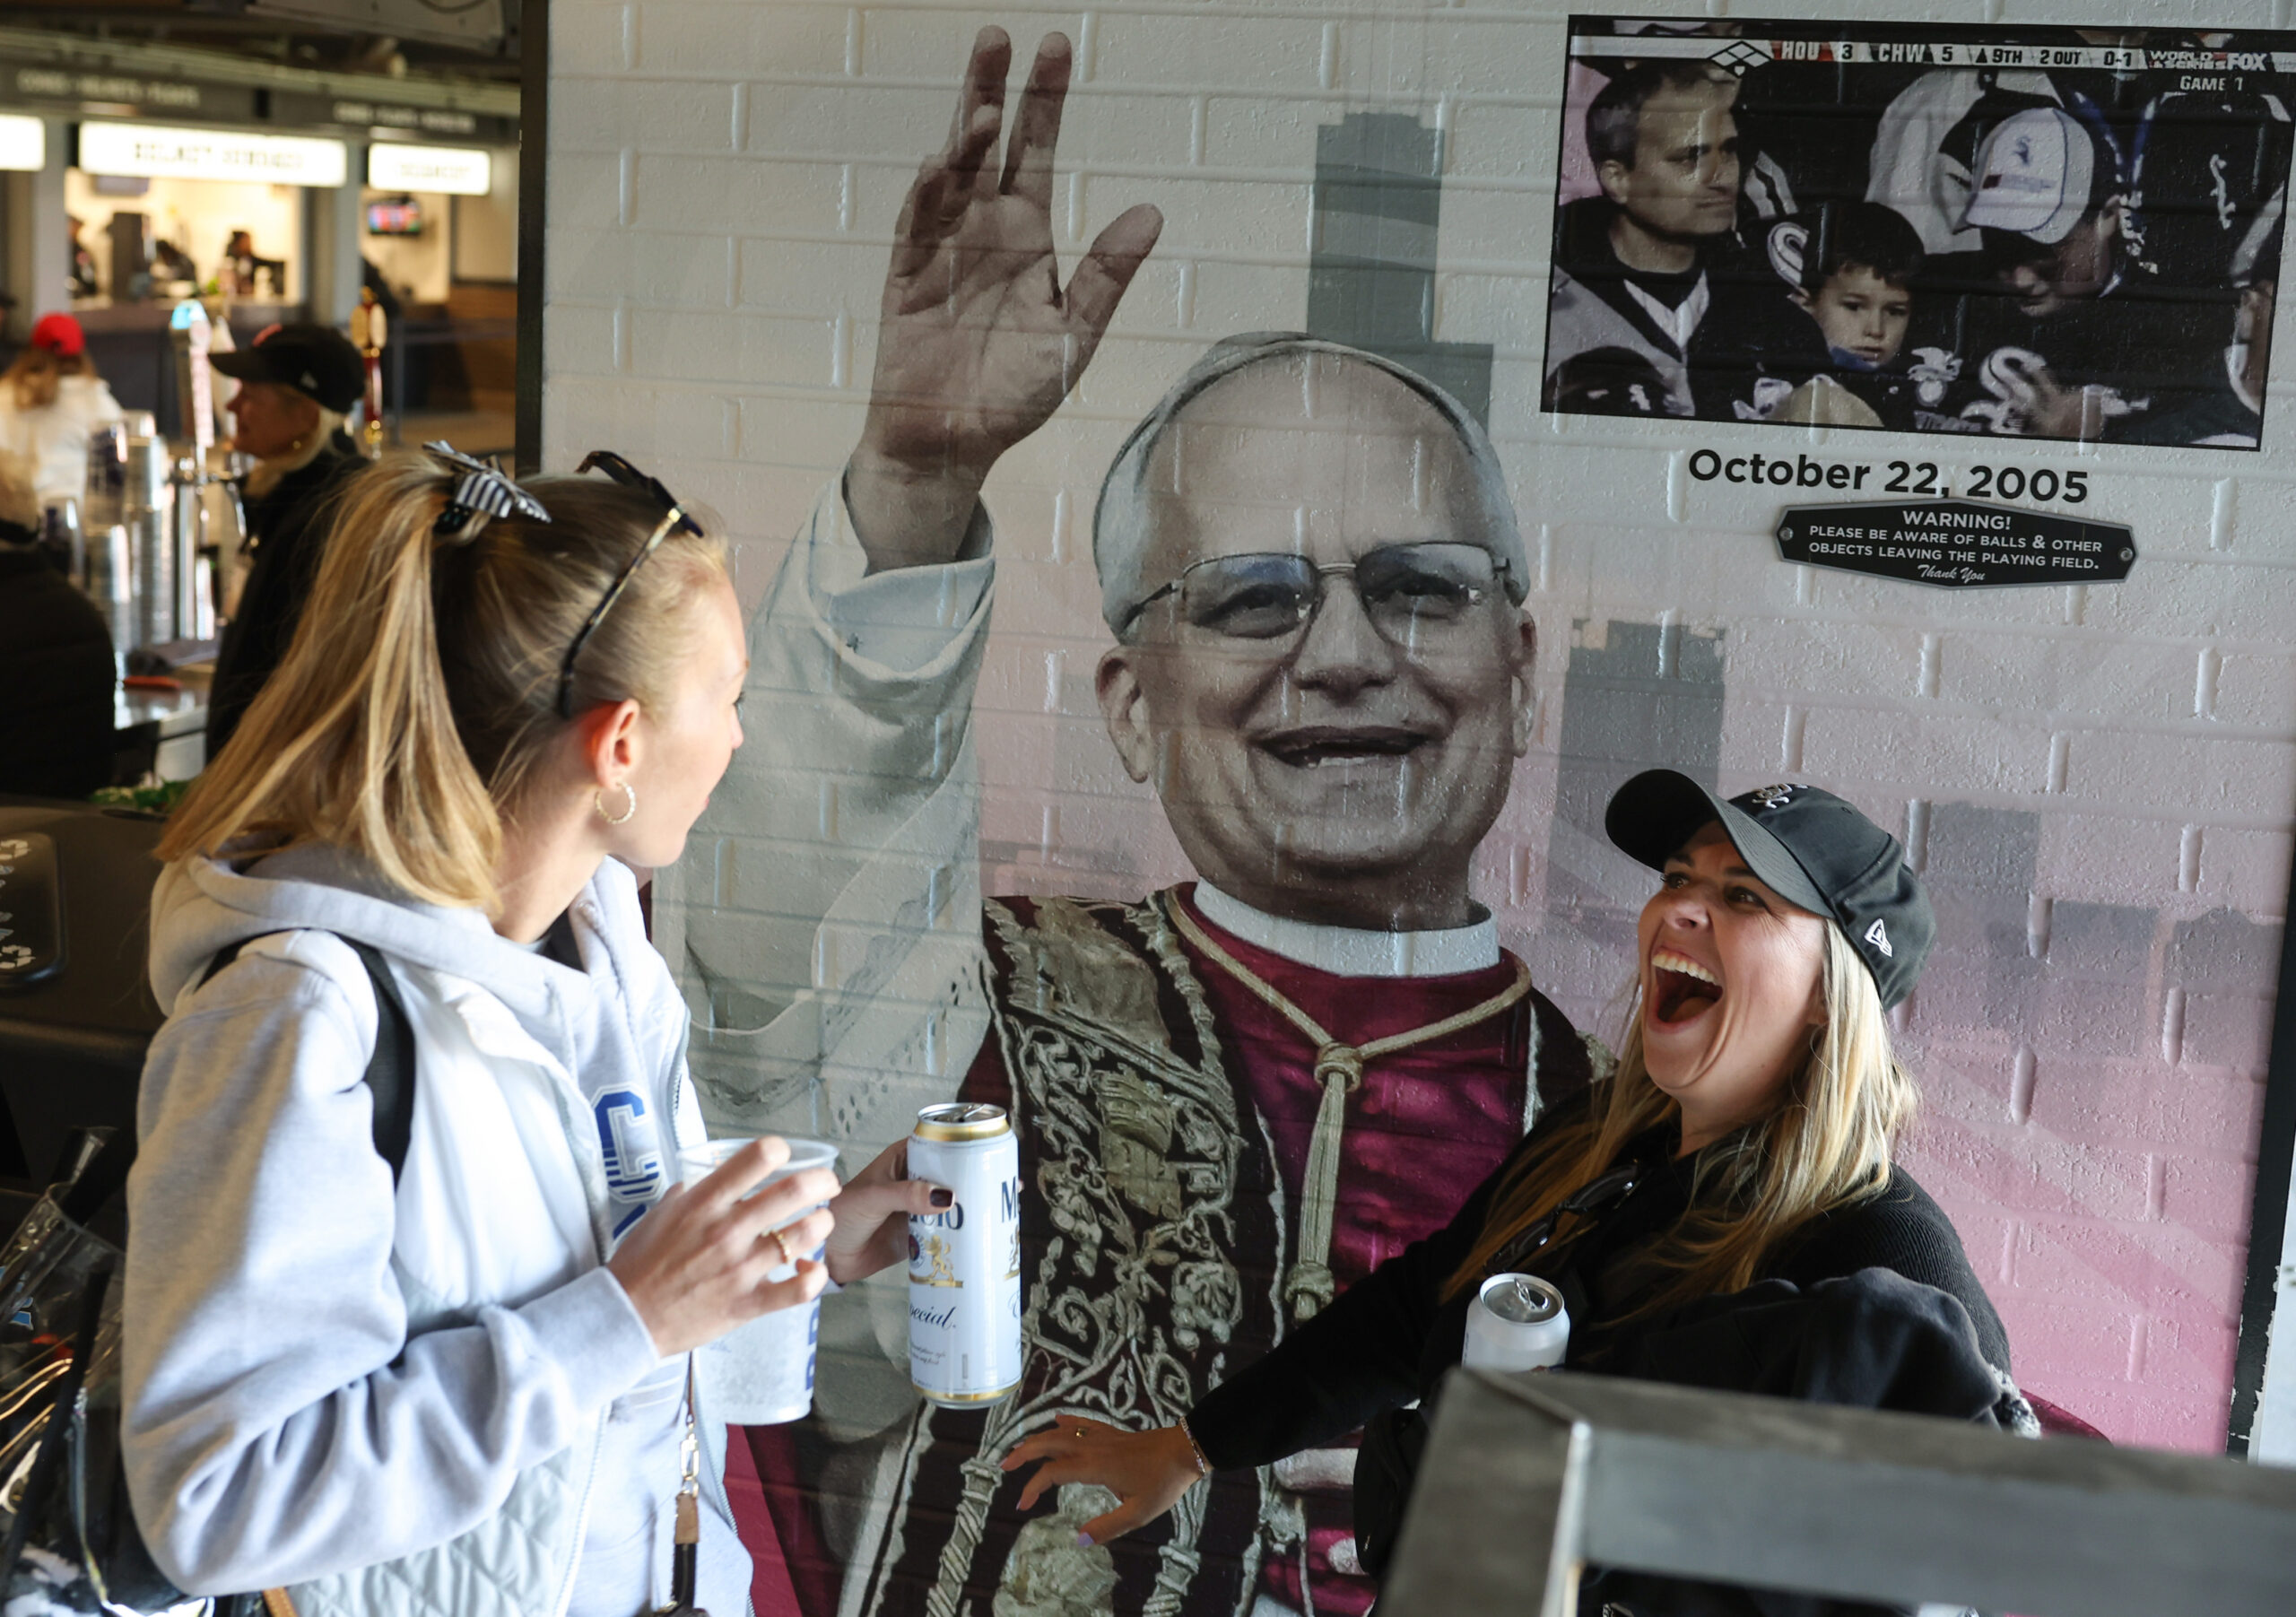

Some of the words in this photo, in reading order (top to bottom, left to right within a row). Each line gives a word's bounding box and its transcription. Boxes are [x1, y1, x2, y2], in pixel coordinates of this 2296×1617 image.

[1781, 41, 1820, 60] HOU
[1841, 44, 1853, 60] 3
[1878, 43, 1926, 63] CHW
[1941, 46, 1953, 62] 5
[1991, 48, 2023, 64] 9TH
[2039, 49, 2050, 65] 2
[2054, 50, 2082, 65] OUT
[2150, 50, 2213, 61] WORLD
[2226, 52, 2268, 71] FOX
[2179, 75, 2226, 91] GAME
[2231, 77, 2244, 91] 1
[1689, 449, 1870, 490] October
[1884, 461, 1950, 498] 22,
[1967, 465, 2089, 503] 2005
[1902, 510, 2011, 530] WARNING!
[1810, 526, 1864, 538] PLEASE
[1869, 529, 1888, 540] BE
[1893, 531, 1948, 543] AWARE
[1953, 535, 1976, 545] OF
[1980, 535, 2027, 548] BALLS
[2032, 535, 2046, 550] &
[2052, 540, 2102, 552] OTHER
[1809, 543, 1873, 556] OBJECTS
[1879, 546, 1942, 561] LEAVING
[1948, 551, 1976, 562] THE
[1982, 552, 2046, 566] PLAYING
[2052, 557, 2100, 569] FIELD.
[1918, 564, 1957, 579] Thank
[1961, 566, 1986, 583] You
